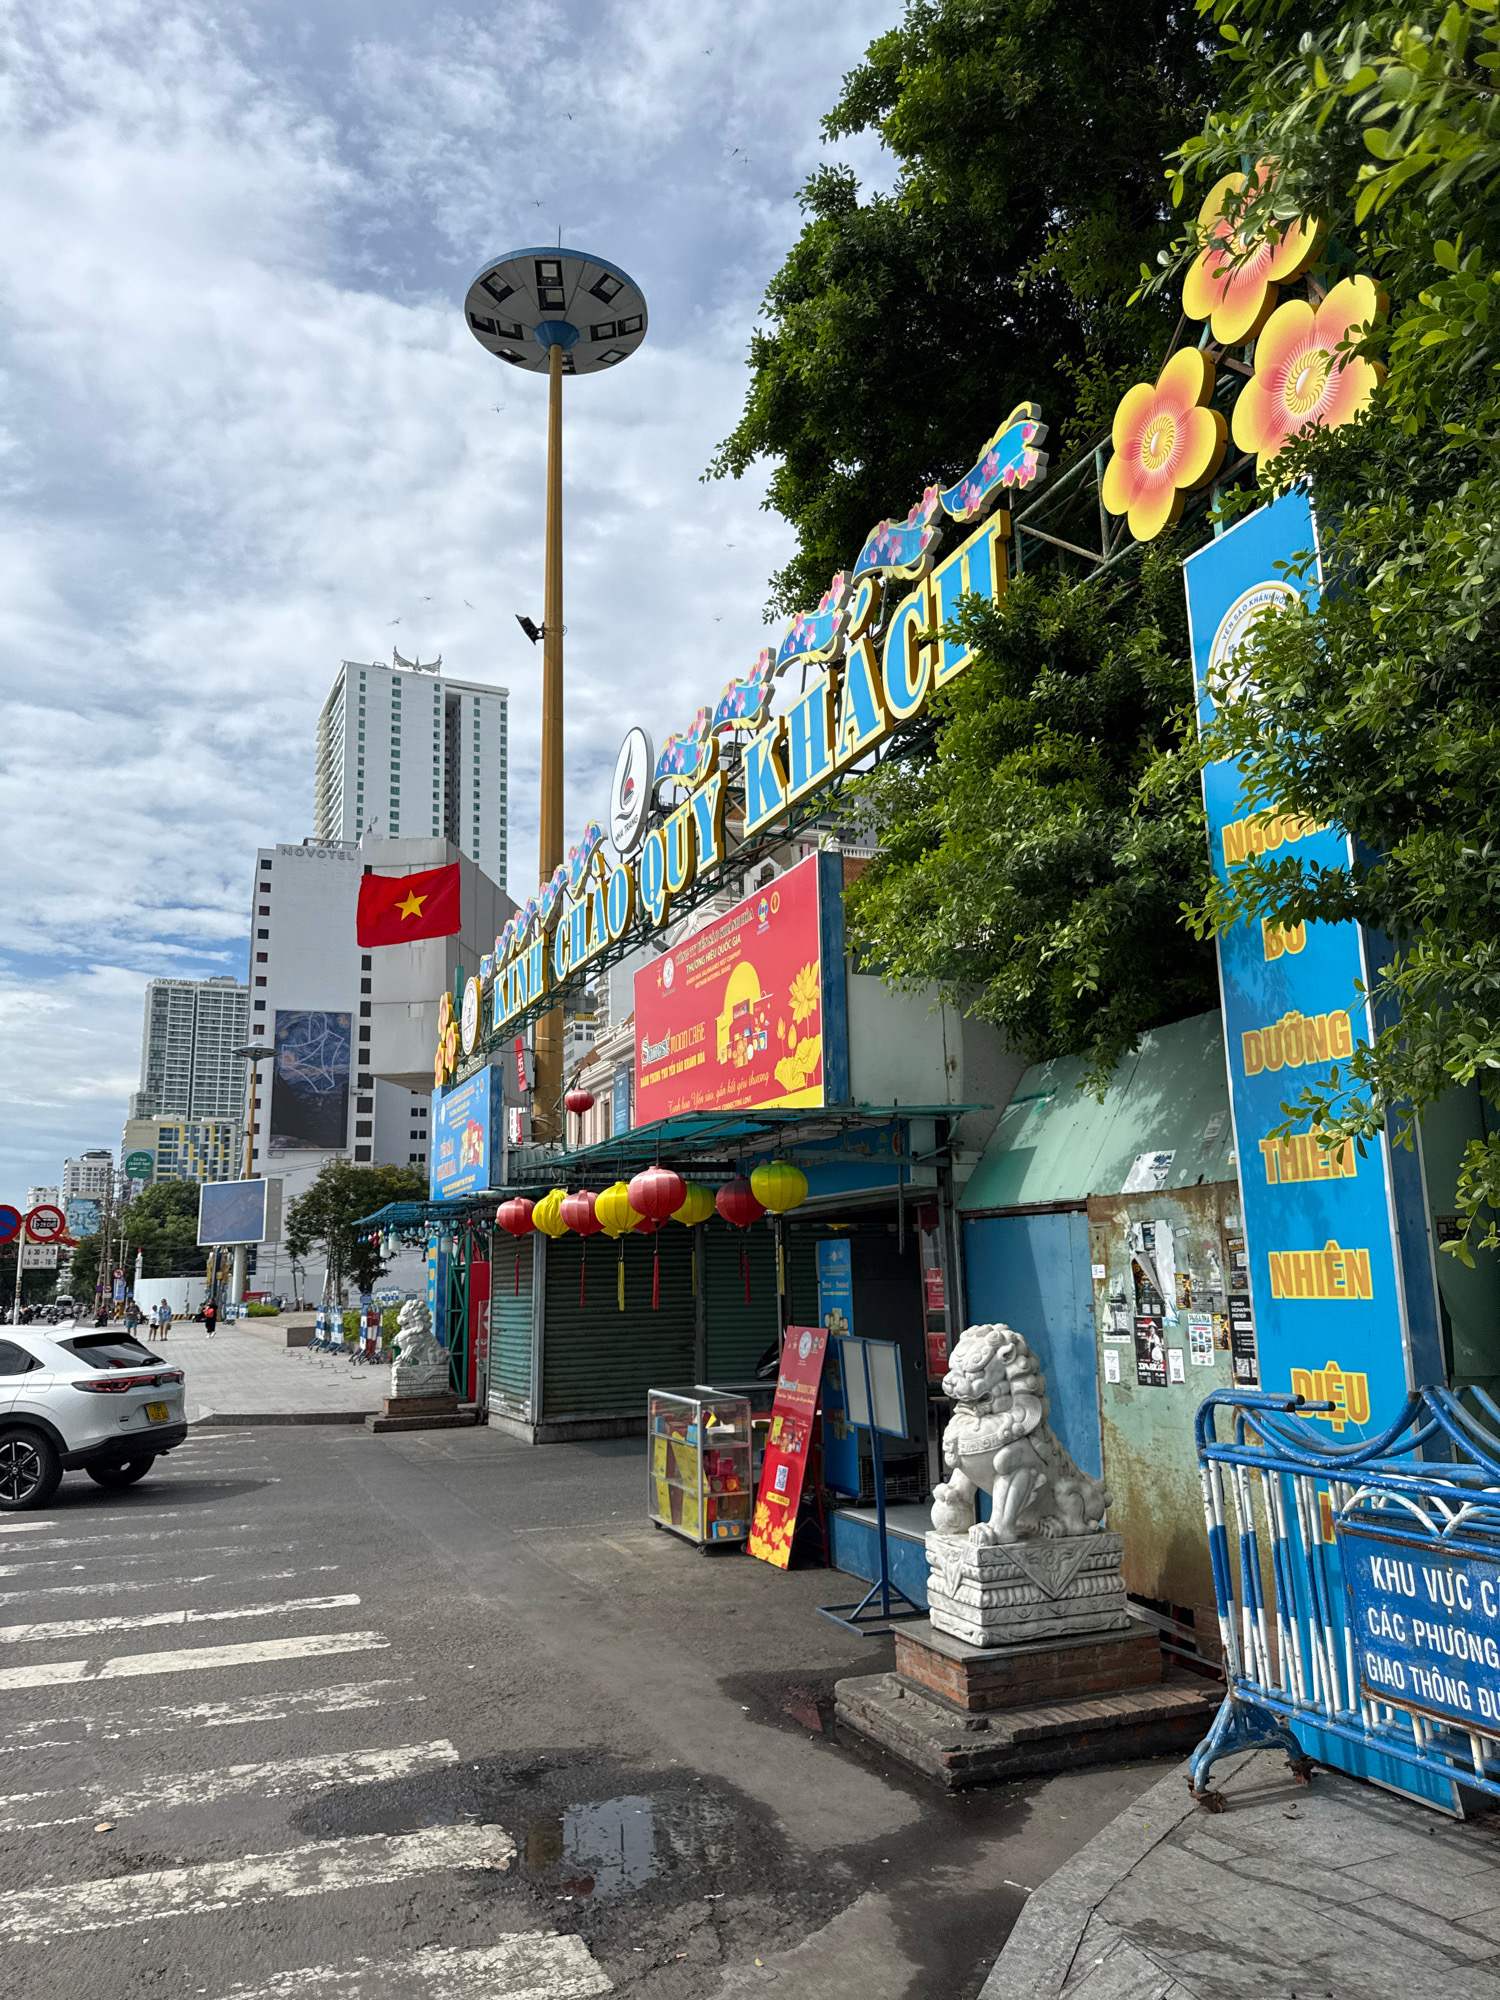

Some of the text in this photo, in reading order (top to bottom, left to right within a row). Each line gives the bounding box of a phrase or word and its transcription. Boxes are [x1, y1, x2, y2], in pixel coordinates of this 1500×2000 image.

[492, 509, 1010, 1032] KÍNH CHÀO QUÝ KHÁCH
[281, 846, 355, 861] NOVOTEL
[623, 814, 639, 835] TRANG
[1242, 1009, 1353, 1076] DƯỠNG
[1259, 1122, 1357, 1185] THIÊN
[1268, 1239, 1373, 1300] NHIÊN
[1290, 1360, 1371, 1434] DIỆU
[1370, 1555, 1500, 1618] KHU VỰC C
[1367, 1603, 1500, 1670] CÁC PHƯƠNG
[1366, 1652, 1406, 1690] GIAO
[1409, 1665, 1473, 1712] THÔNG
